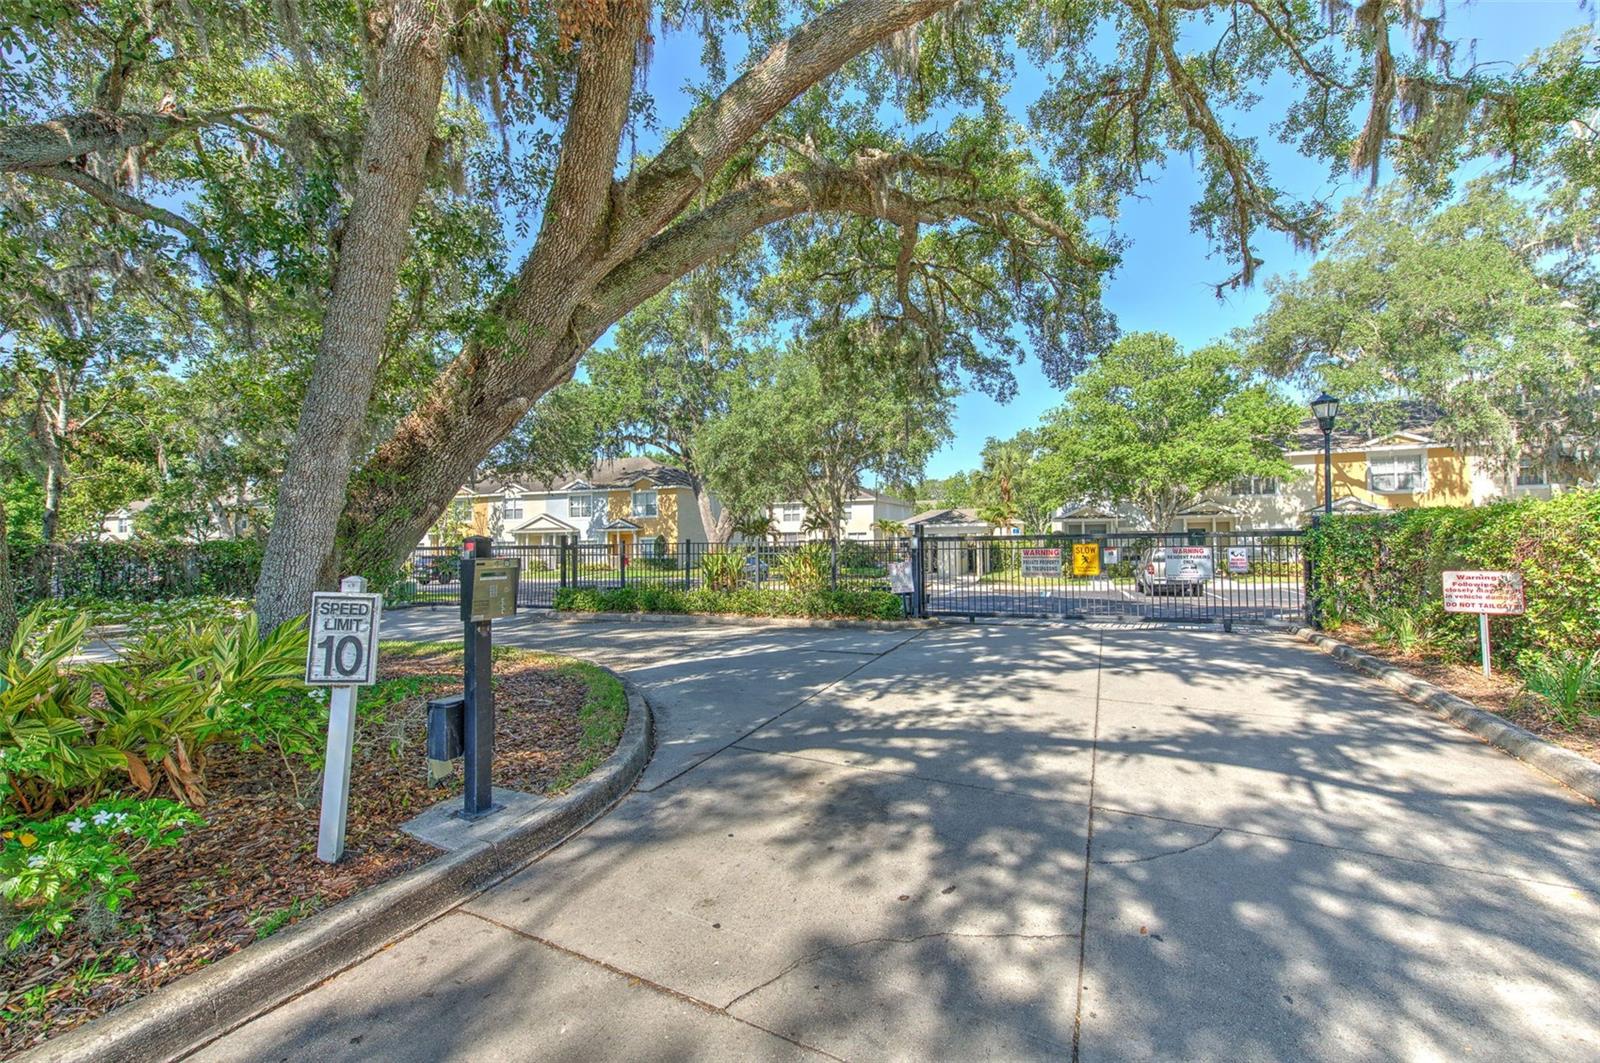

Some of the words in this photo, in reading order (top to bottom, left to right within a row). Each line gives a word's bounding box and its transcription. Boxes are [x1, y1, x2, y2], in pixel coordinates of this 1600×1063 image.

[1075, 546, 1096, 554] SLOW
[320, 602, 369, 616] SPEED
[324, 618, 363, 632] LIMIT
[317, 635, 363, 677] 10
